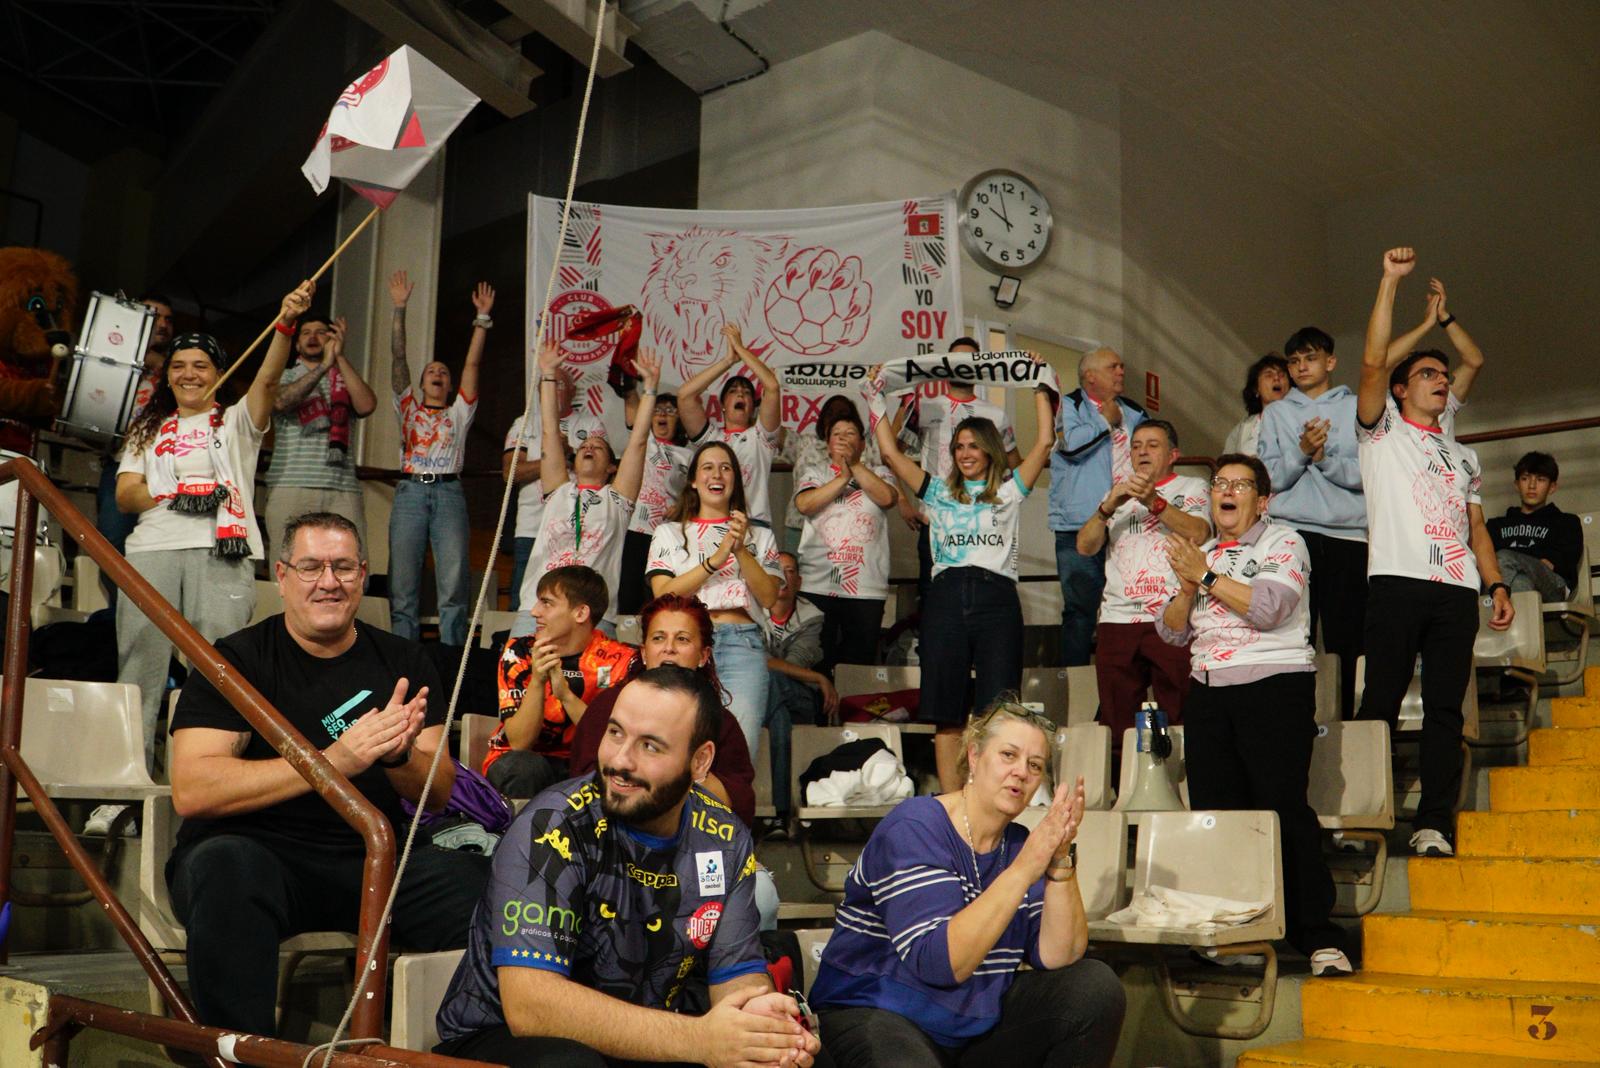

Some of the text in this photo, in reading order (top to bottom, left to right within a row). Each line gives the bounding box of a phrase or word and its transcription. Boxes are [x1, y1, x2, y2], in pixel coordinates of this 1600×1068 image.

[989, 183, 998, 194] 11
[1002, 182, 1015, 194] 12
[976, 193, 989, 205] 10
[1020, 191, 1025, 201] 1
[970, 208, 979, 219] 9
[1029, 205, 1039, 216] 2
[974, 227, 984, 238] 8
[1033, 223, 1042, 234] 3
[984, 241, 993, 252] 7
[1027, 240, 1036, 250] 4
[1000, 250, 1010, 261] 6
[1016, 249, 1025, 260] 5
[567, 293, 594, 302] CLUB
[915, 289, 933, 306] YO
[901, 310, 948, 340] SOY
[906, 356, 1047, 383] Ademar
[785, 376, 847, 388] Balonmano
[1501, 524, 1549, 539] HOODRICH
[948, 534, 1005, 547] ABANCA
[827, 551, 865, 567] CAZURRA
[1136, 568, 1166, 584] ZARPA
[1124, 584, 1170, 598] CAZURRA
[1527, 1004, 1557, 1041] 3
